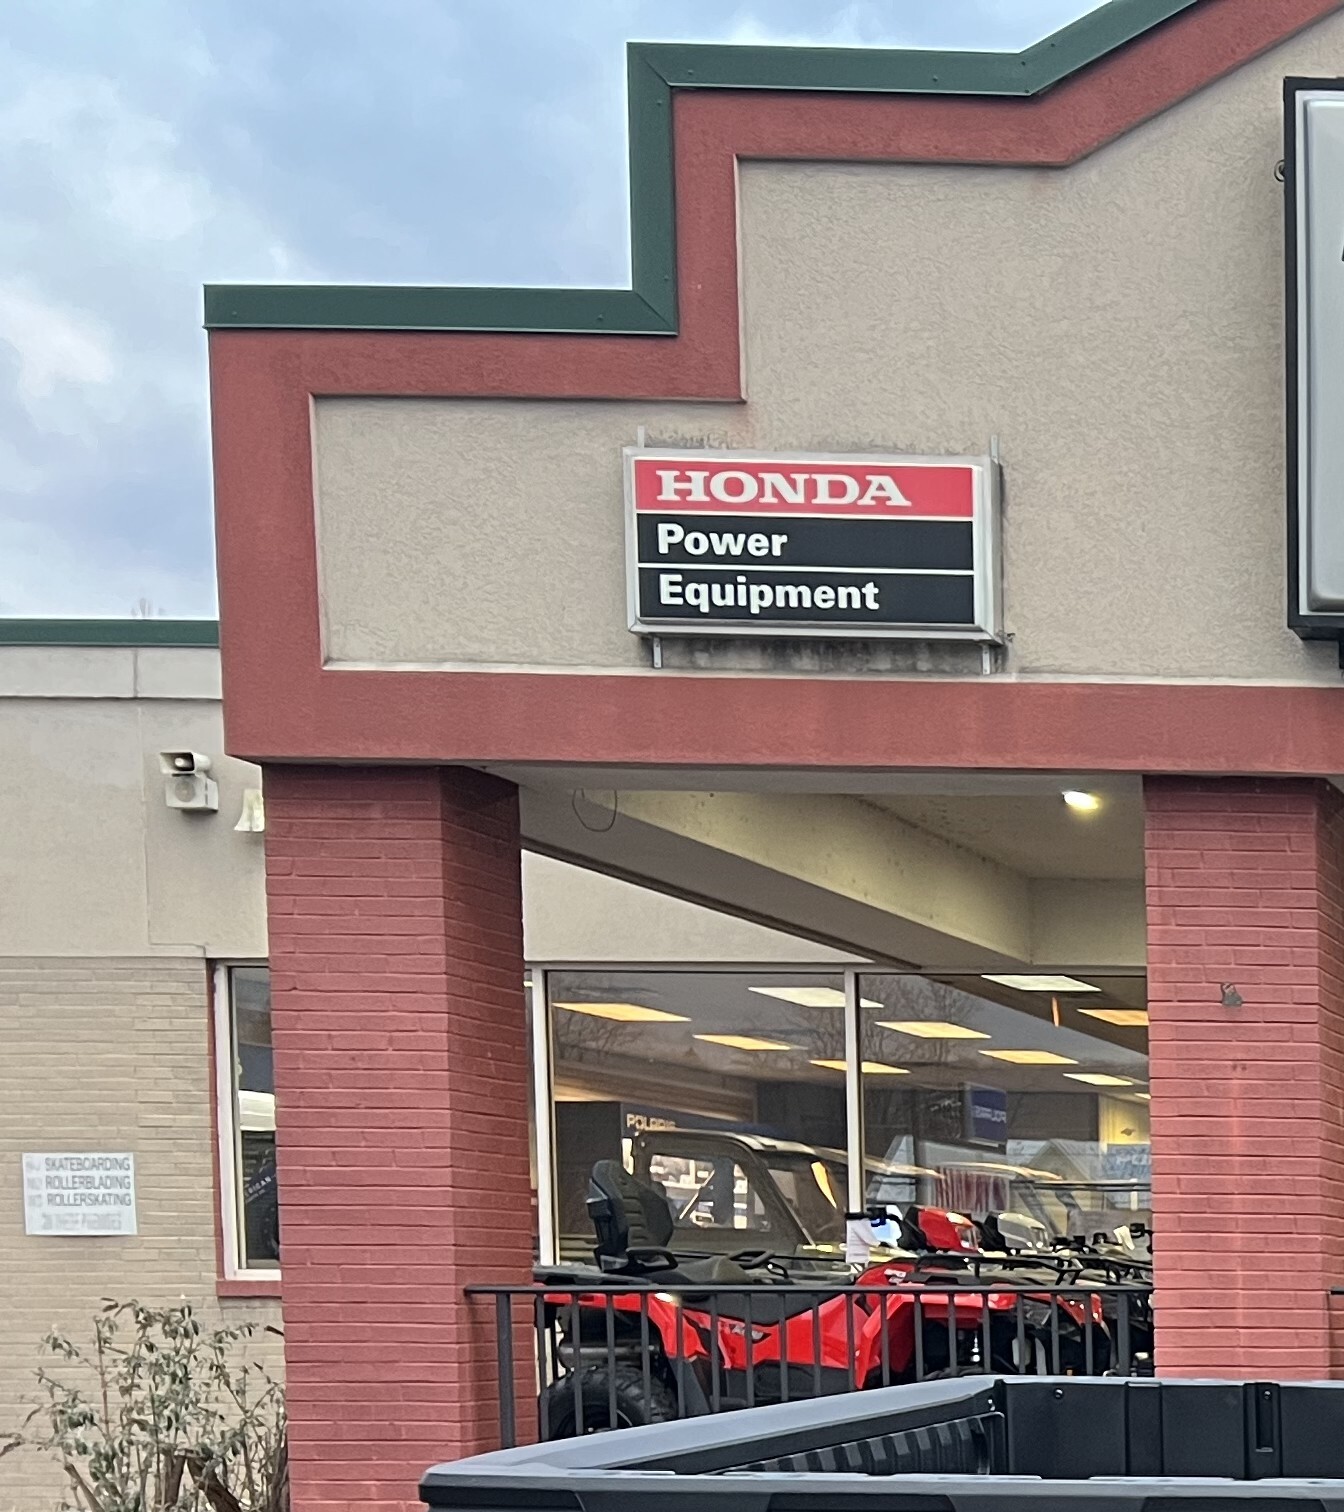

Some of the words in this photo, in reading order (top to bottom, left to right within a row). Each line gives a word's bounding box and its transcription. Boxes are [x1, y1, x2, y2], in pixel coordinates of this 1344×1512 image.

[655, 469, 912, 507] HONDA
[656, 522, 788, 557] Power
[658, 573, 880, 614] Equipment
[44, 1156, 131, 1172] SKATEBOARDING
[45, 1175, 132, 1190] ROLLERBLADING
[46, 1193, 132, 1207] ROLLERSKATING
